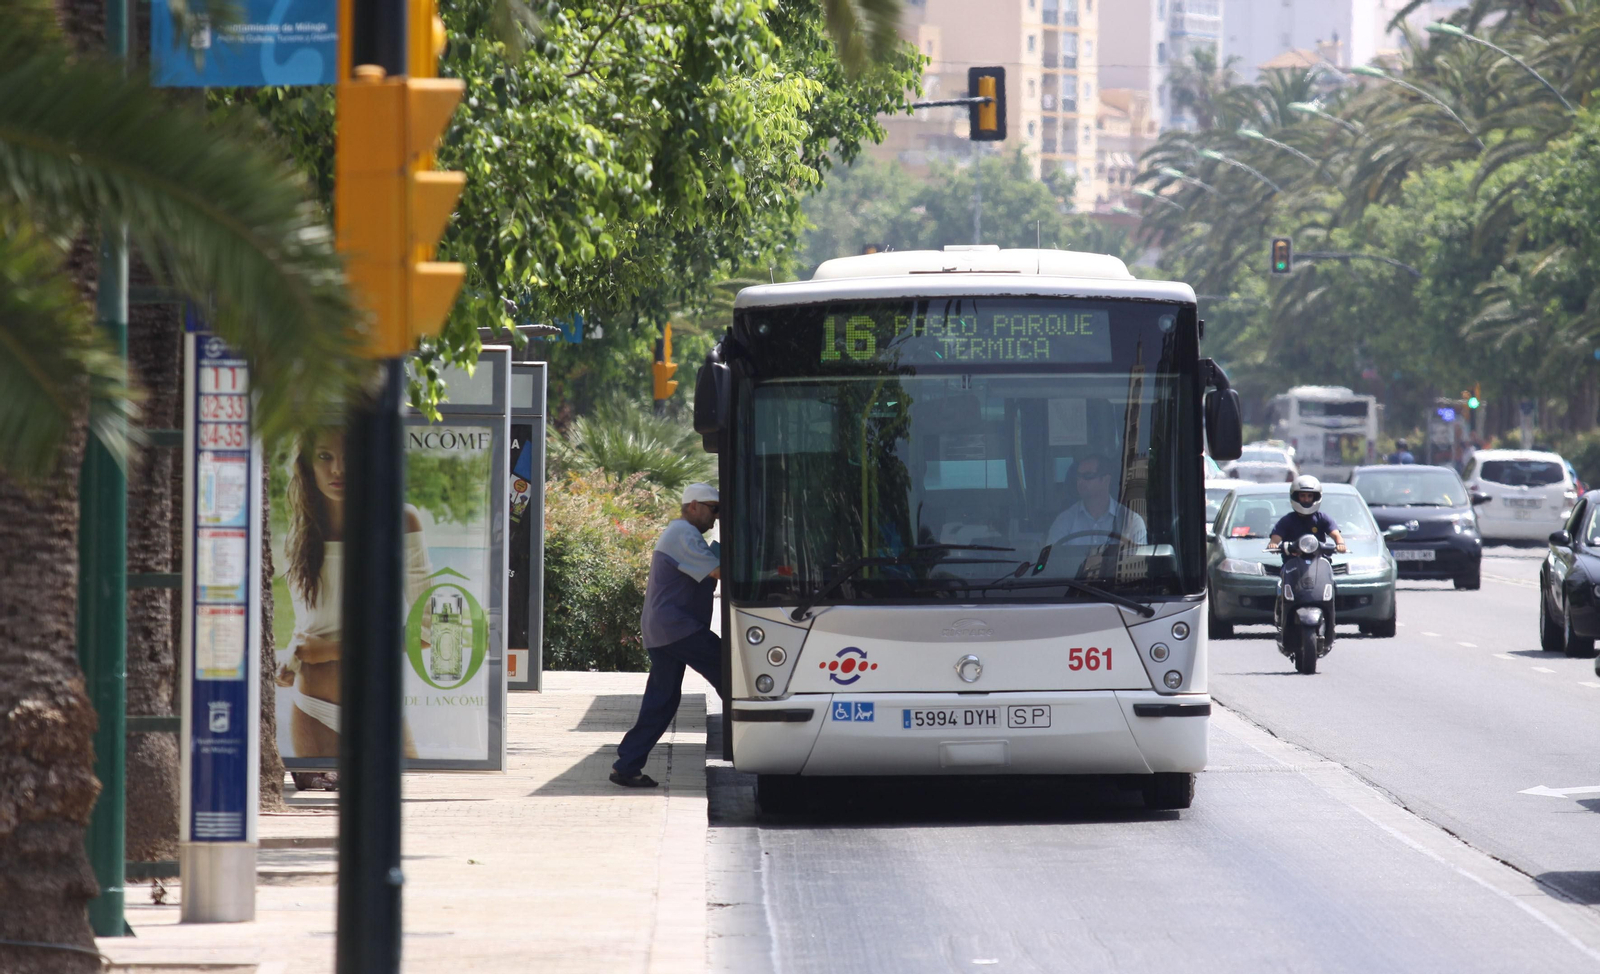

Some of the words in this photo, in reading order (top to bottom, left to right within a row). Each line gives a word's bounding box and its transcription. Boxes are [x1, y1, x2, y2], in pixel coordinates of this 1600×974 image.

[821, 316, 876, 360] 16
[895, 315, 976, 337] PASEO
[993, 314, 1093, 335] PARQUE
[939, 338, 1050, 359] TERMICA
[211, 366, 237, 390] 11
[202, 394, 245, 419] 32-33
[200, 423, 243, 447] 34-35
[1068, 647, 1112, 671] 561
[404, 696, 421, 706] DE
[426, 694, 488, 706] LANCÔME
[914, 710, 958, 727] 5994
[964, 709, 996, 726] DYH
